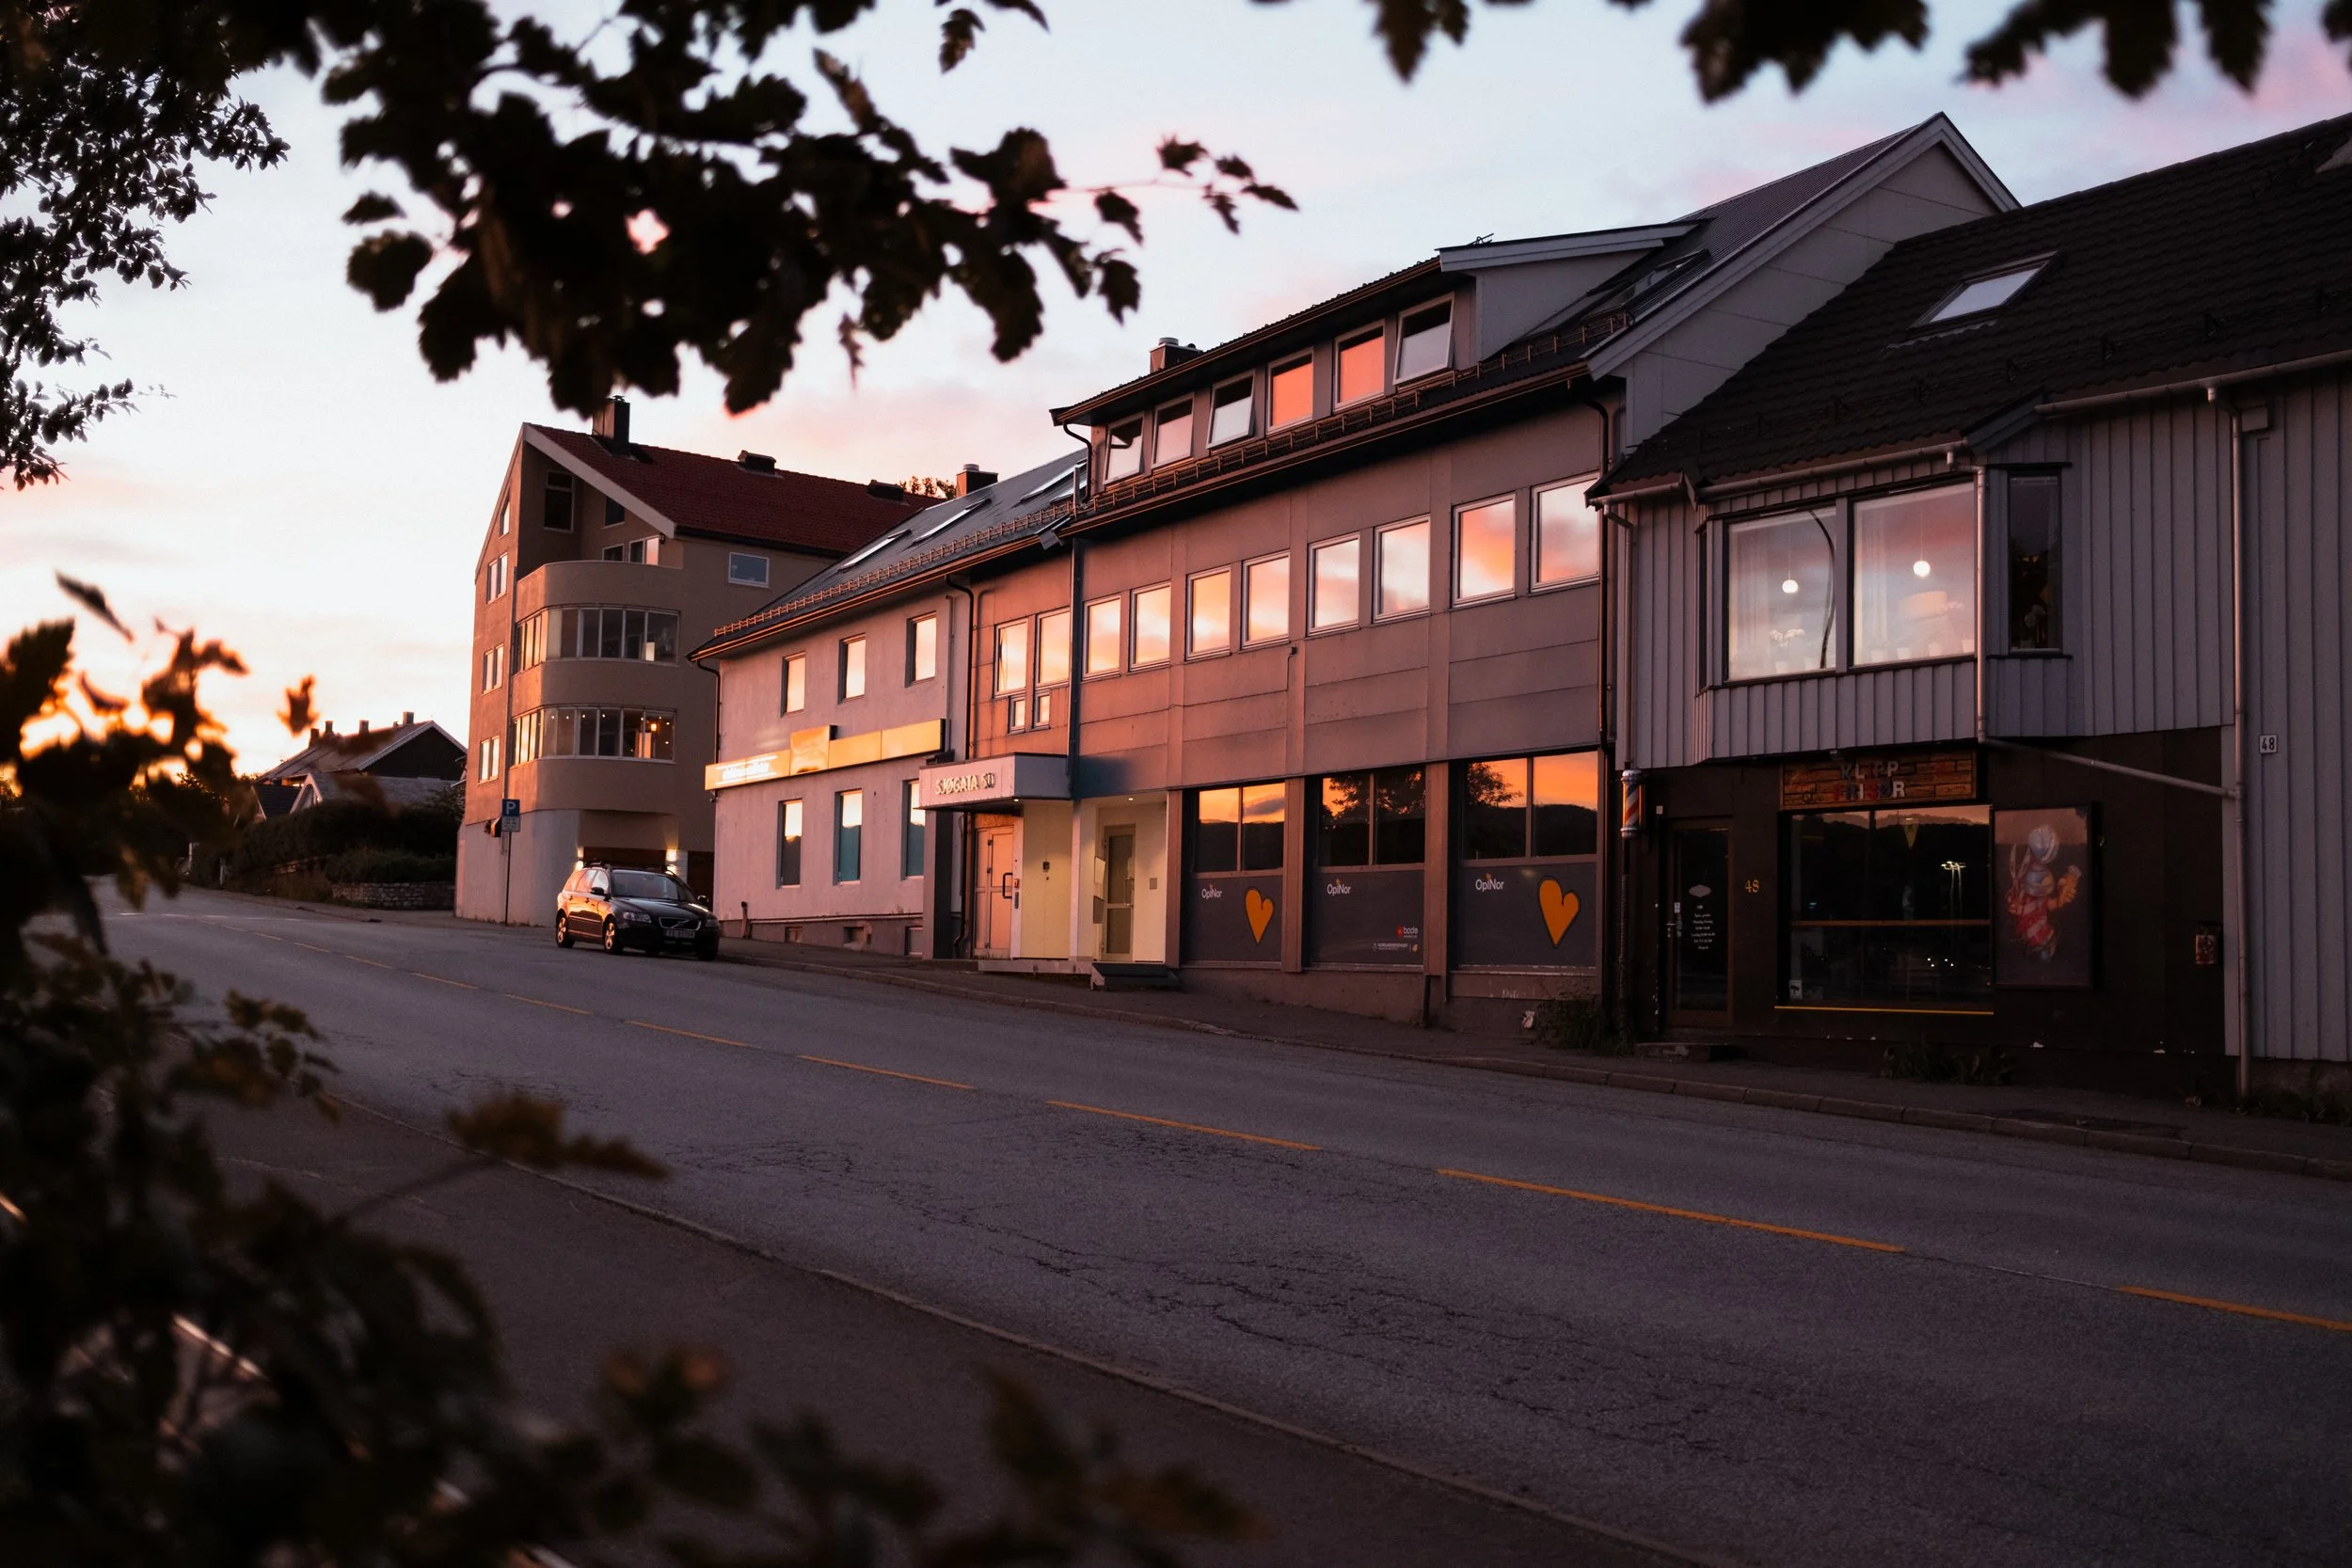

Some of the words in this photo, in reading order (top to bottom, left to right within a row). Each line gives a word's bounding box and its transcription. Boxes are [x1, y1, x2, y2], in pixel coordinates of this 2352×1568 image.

[2262, 736, 2275, 751] 48
[1841, 760, 1899, 781] KLPP
[935, 774, 978, 795] SJØGATA
[506, 800, 516, 815] P
[1475, 877, 1504, 893] OpiNor
[1744, 879, 1759, 894] 48
